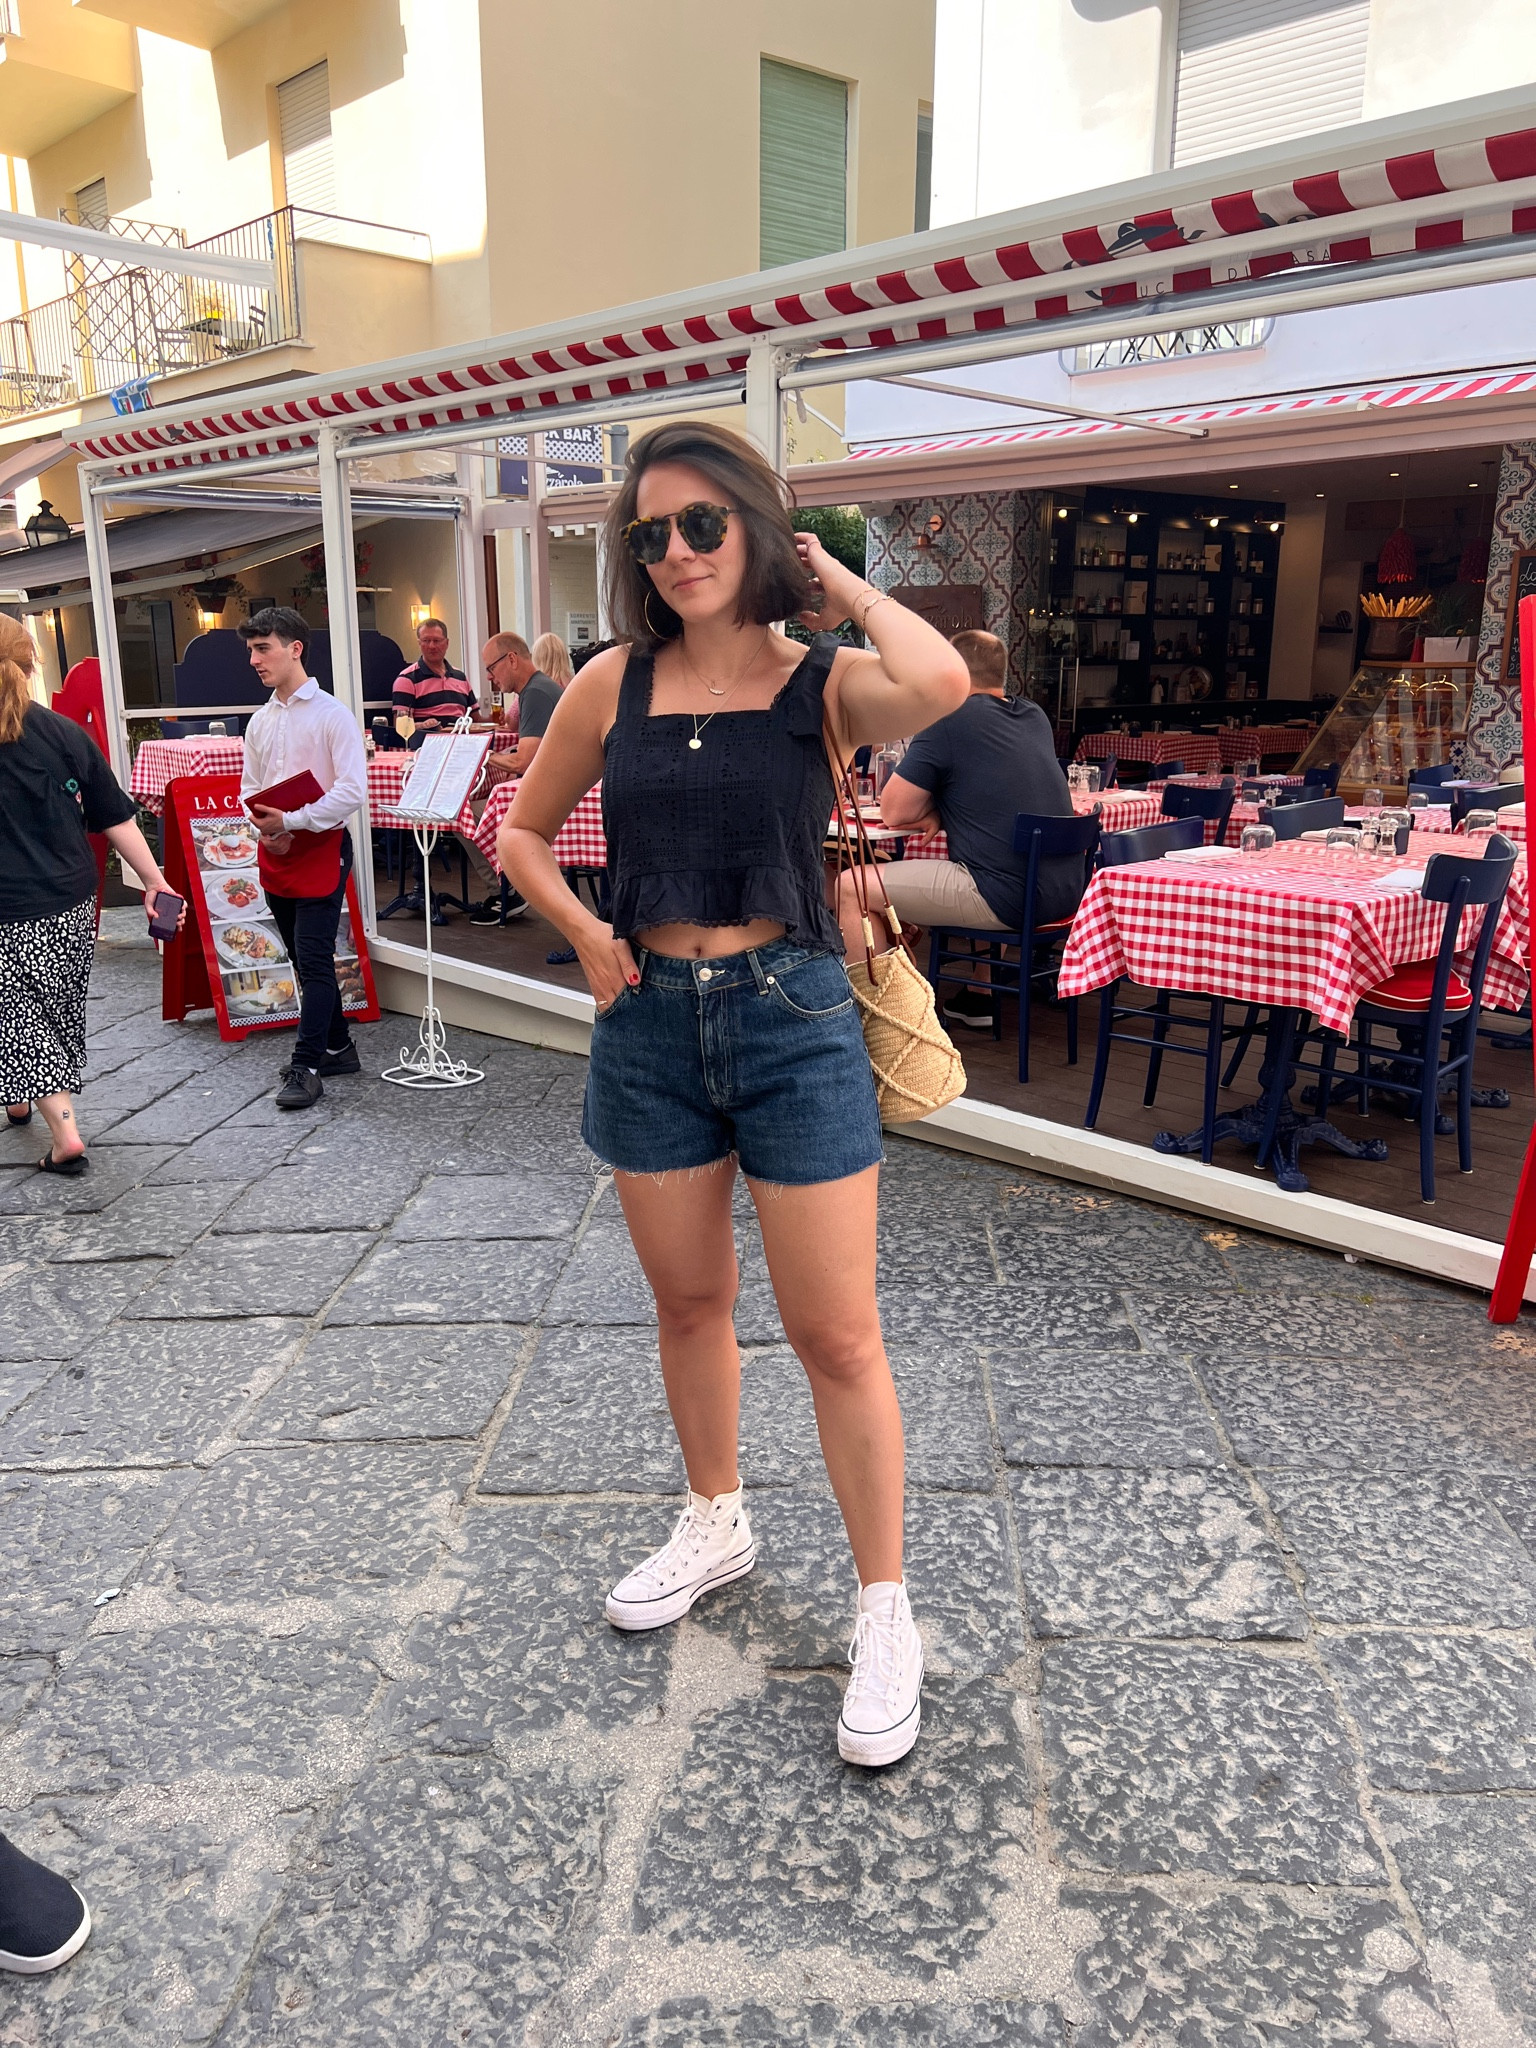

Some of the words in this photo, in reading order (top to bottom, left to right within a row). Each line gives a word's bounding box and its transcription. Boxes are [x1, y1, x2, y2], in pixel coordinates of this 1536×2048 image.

[1291, 248, 1331, 265] ASA
[563, 428, 592, 442] BAR
[194, 796, 217, 810] LA
